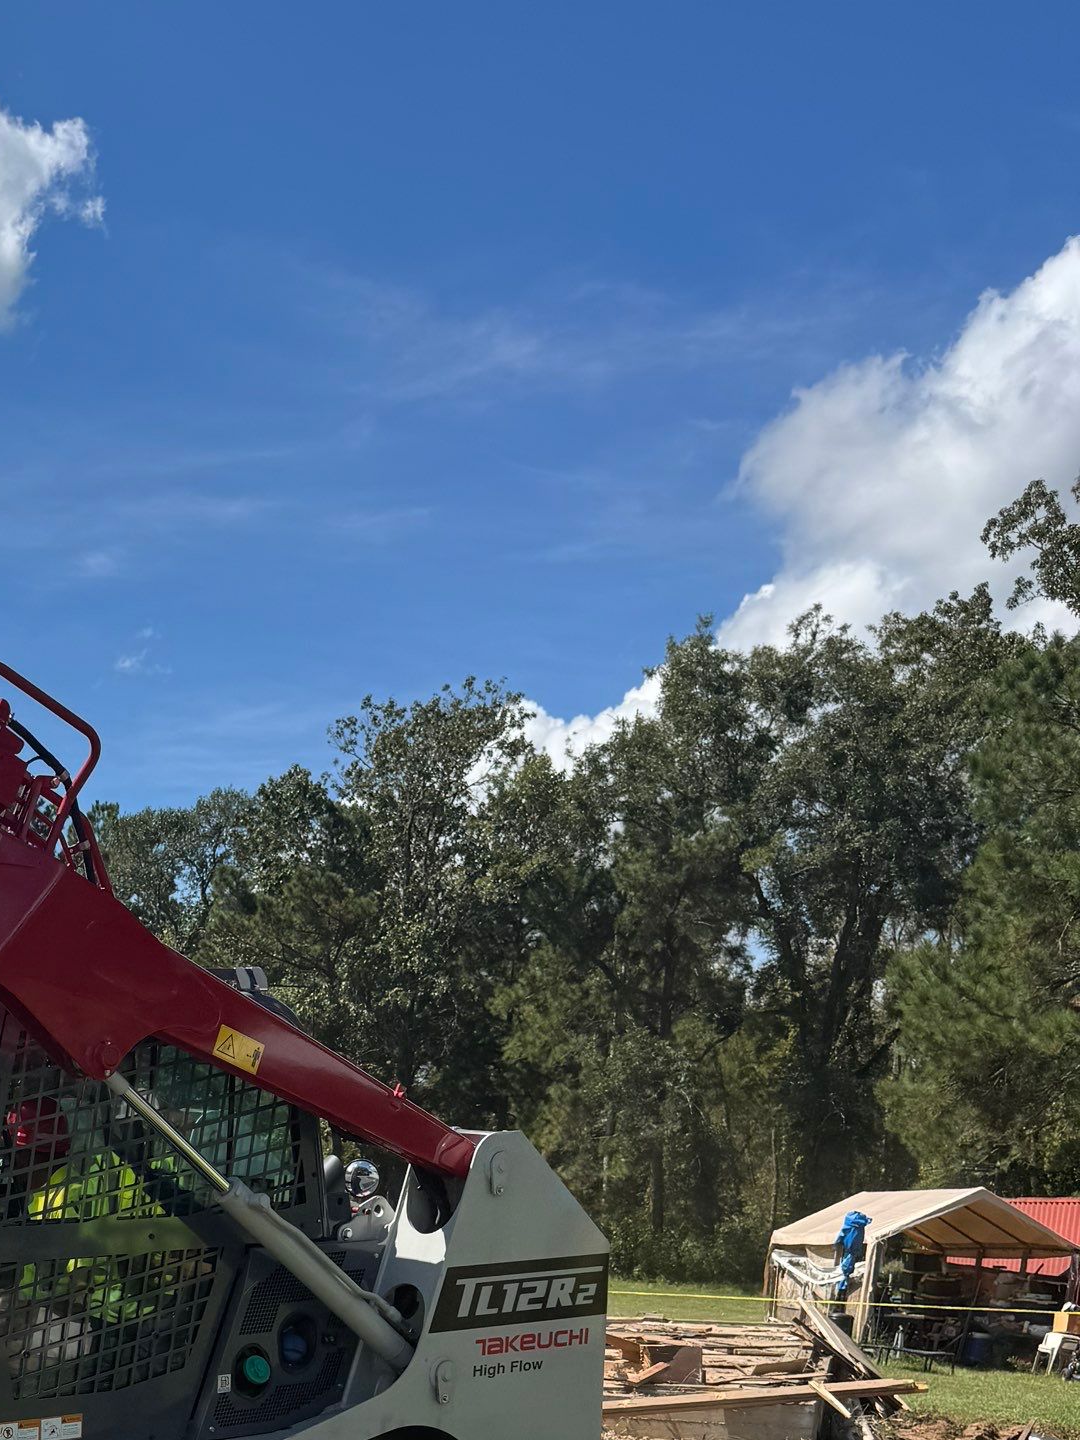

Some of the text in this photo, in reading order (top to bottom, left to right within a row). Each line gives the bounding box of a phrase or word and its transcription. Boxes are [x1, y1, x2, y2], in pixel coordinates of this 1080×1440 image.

[456, 1266, 603, 1318] TL12R2
[473, 1359, 543, 1378] High Flow
